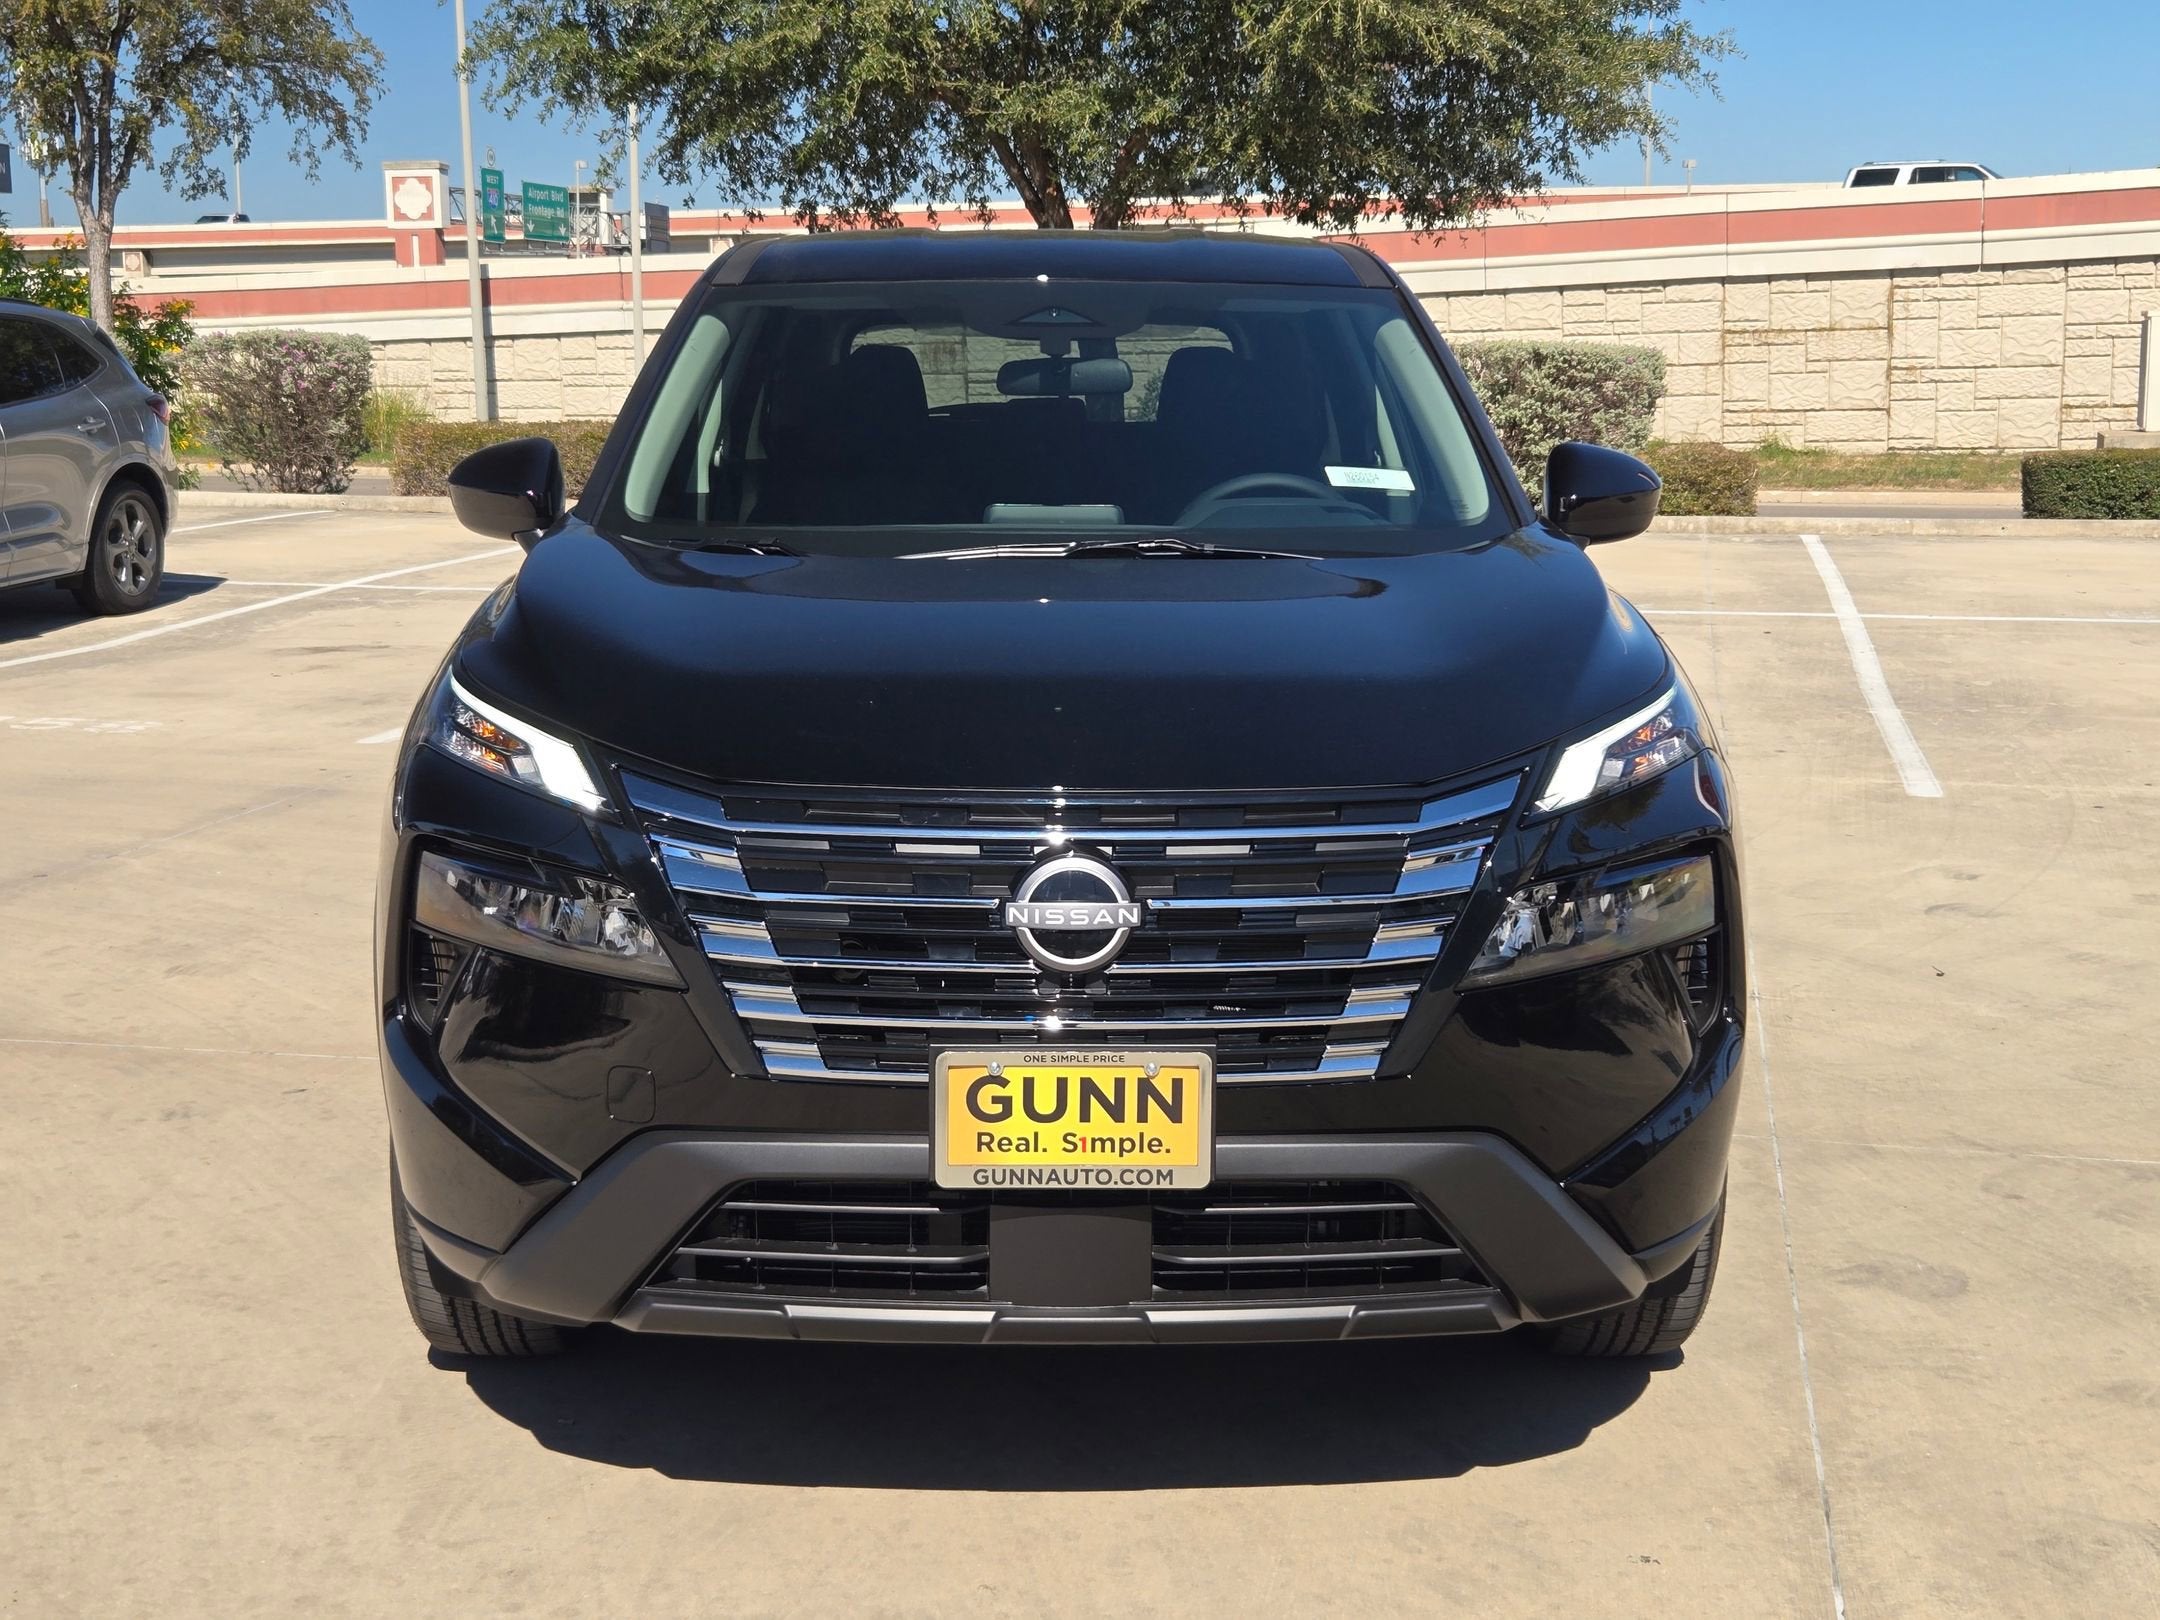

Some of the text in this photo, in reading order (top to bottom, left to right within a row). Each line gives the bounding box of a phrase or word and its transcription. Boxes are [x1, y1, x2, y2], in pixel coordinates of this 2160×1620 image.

[486, 175, 499, 184] WEST
[528, 187, 564, 203] Airport Blvd
[529, 203, 565, 218] Frontage Rd
[1008, 907, 1138, 925] NISSAN
[1023, 1055, 1126, 1063] ONE SIMPLE PRICE
[965, 1075, 1183, 1124] GUNN
[976, 1131, 1048, 1153] Real.
[972, 1168, 1174, 1186] GUNNAUTO.COM
